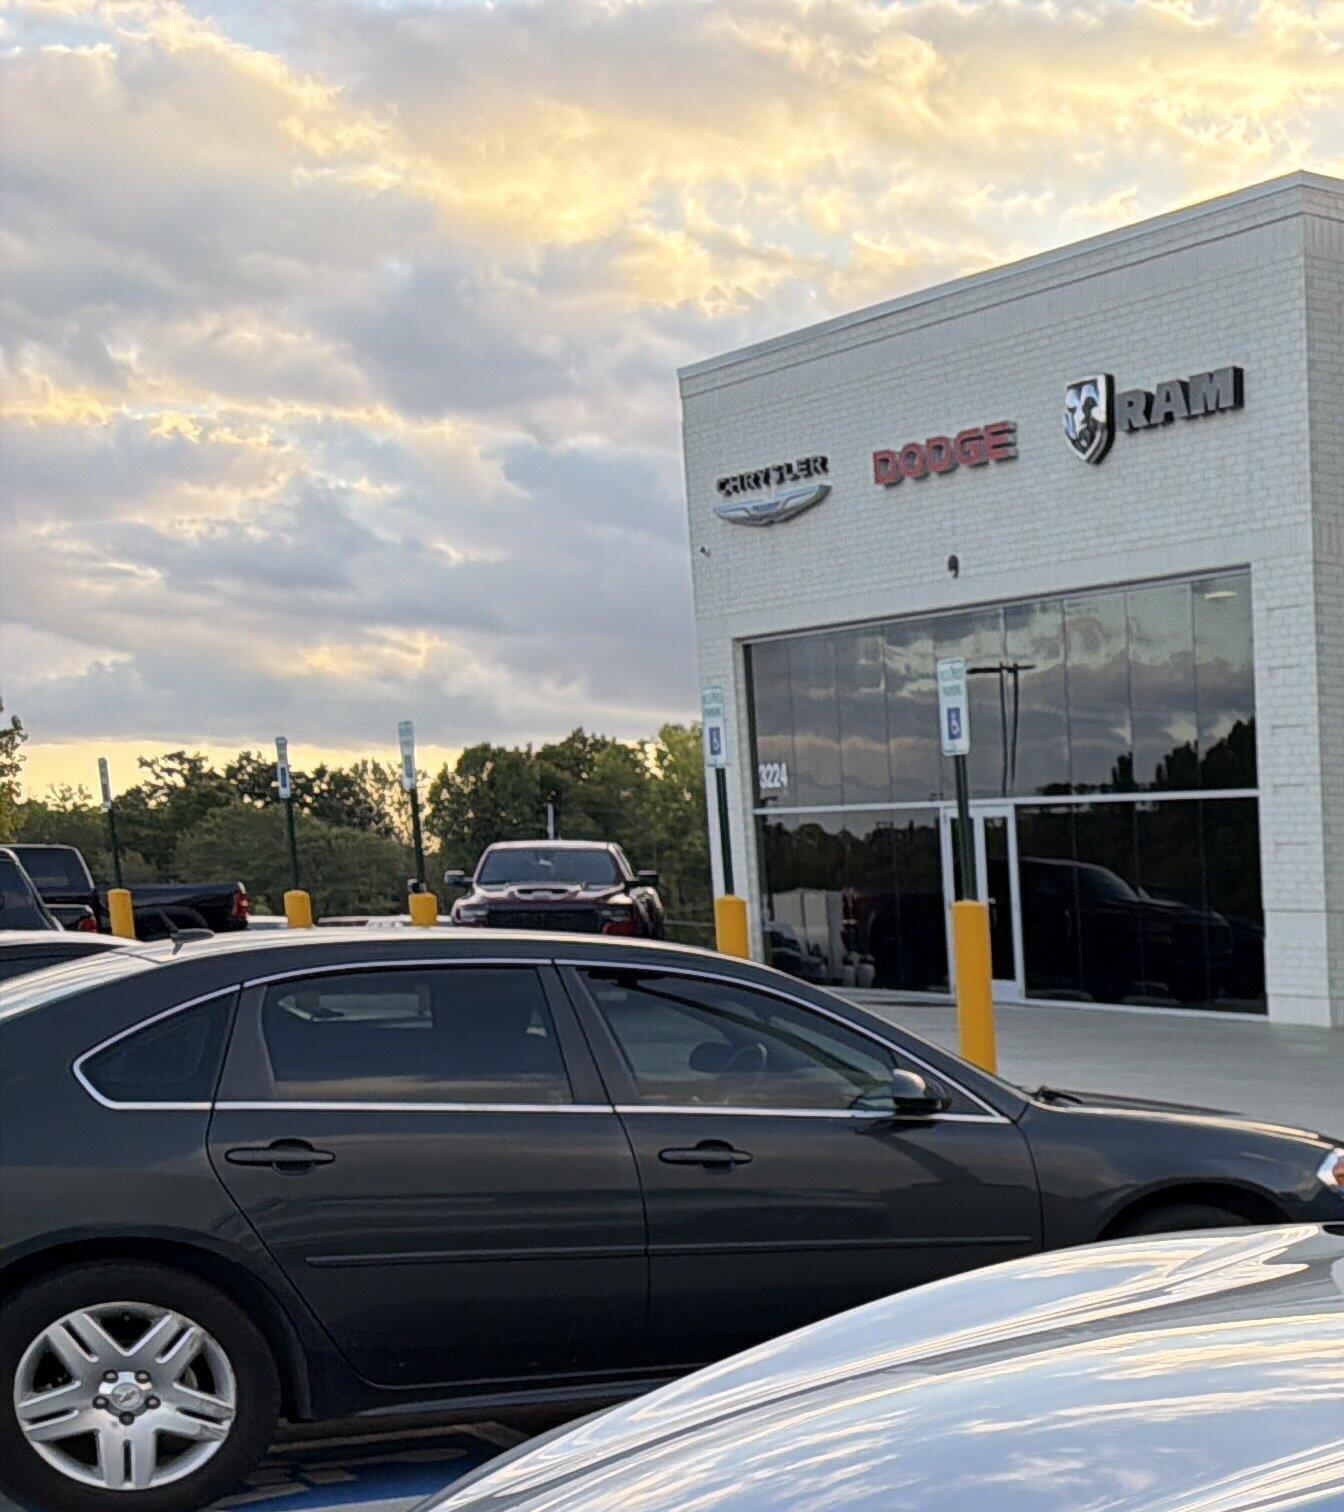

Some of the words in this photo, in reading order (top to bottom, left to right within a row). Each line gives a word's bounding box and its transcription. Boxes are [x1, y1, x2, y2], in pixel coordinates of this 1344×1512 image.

[1115, 366, 1243, 434] RAM
[716, 455, 829, 497] CHRYSLER
[873, 420, 1016, 487] DODGE
[758, 762, 788, 788] 3224
